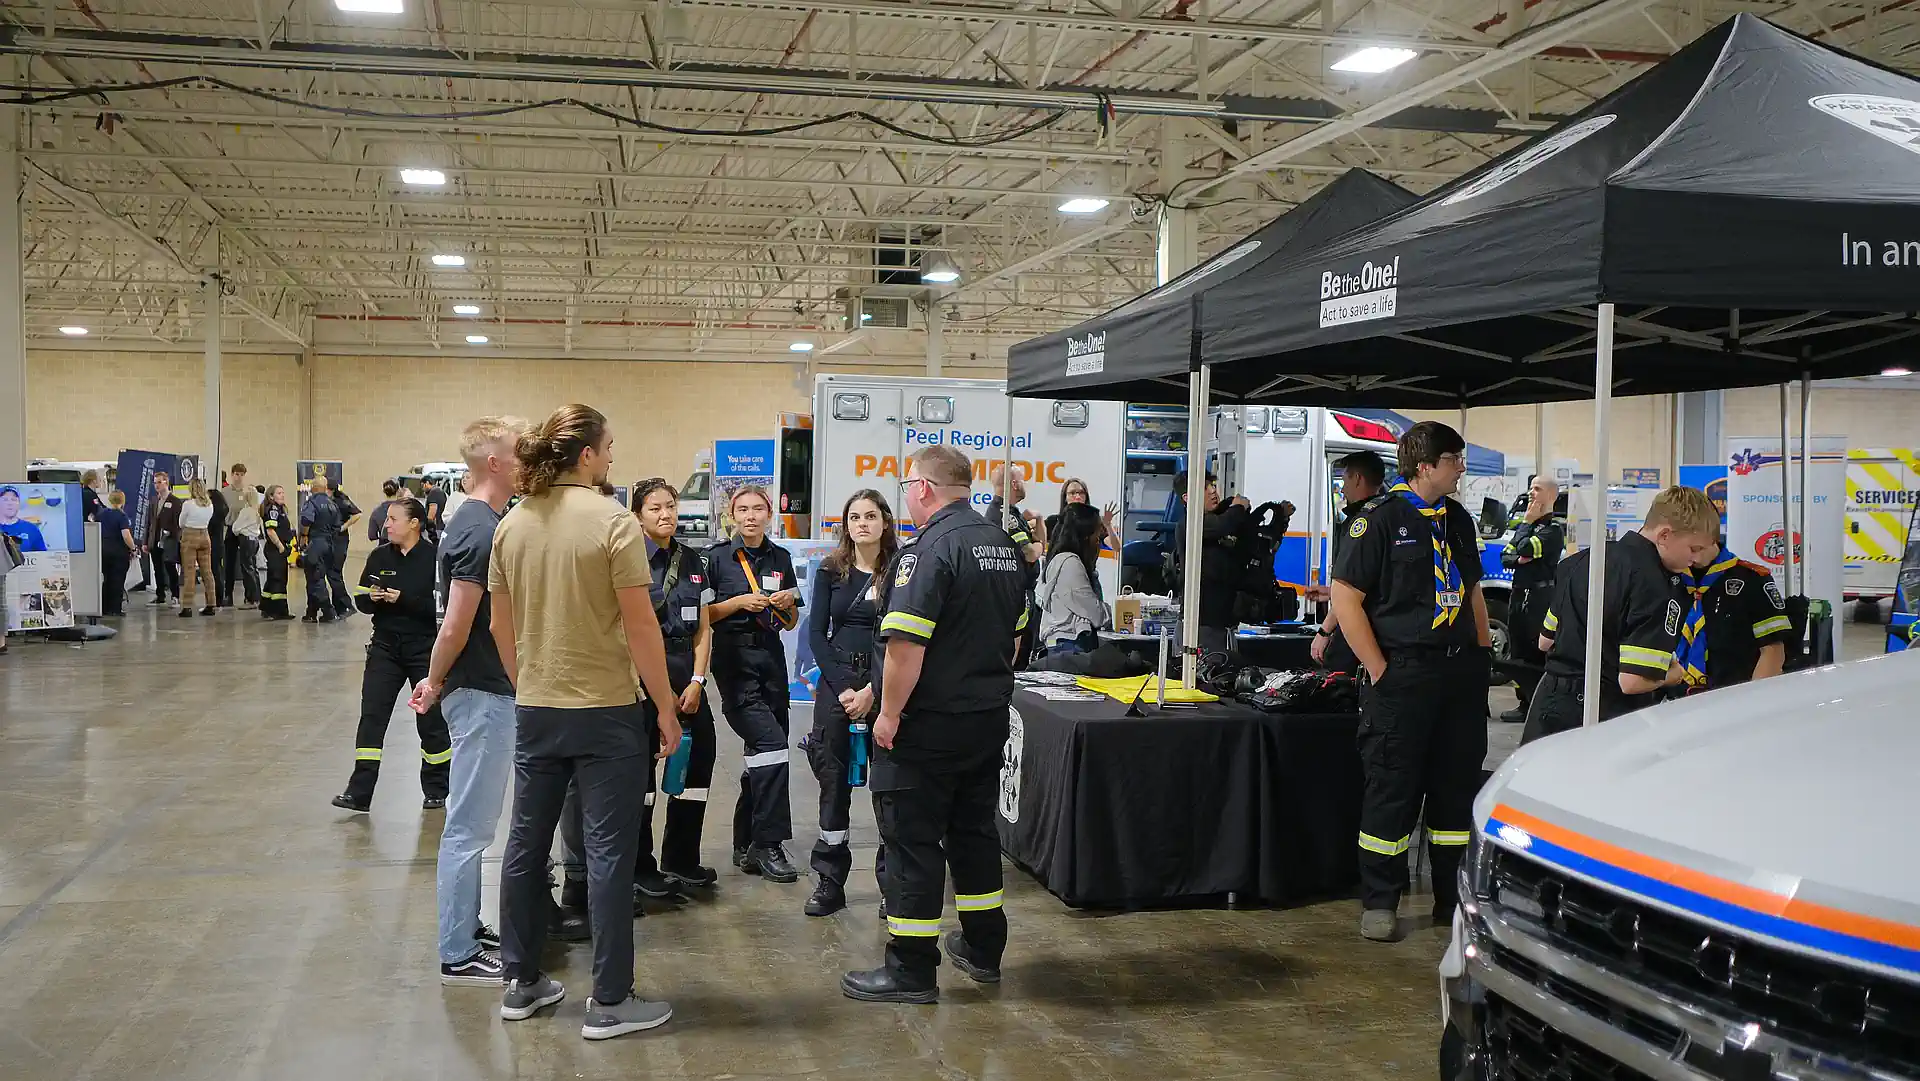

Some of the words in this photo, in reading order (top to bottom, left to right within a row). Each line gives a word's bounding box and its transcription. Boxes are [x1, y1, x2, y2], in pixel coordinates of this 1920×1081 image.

[1843, 233, 1871, 265] In
[1321, 271, 1341, 300] Be
[1342, 273, 1360, 295] the
[1361, 256, 1399, 290] One!
[1322, 307, 1337, 322] Act
[1339, 304, 1348, 318] to
[1349, 302, 1369, 317] save
[1371, 302, 1377, 314] a
[1380, 294, 1394, 313] life
[906, 428, 944, 445] Peel
[728, 455, 739, 463] You
[1813, 496, 1828, 504] BY
